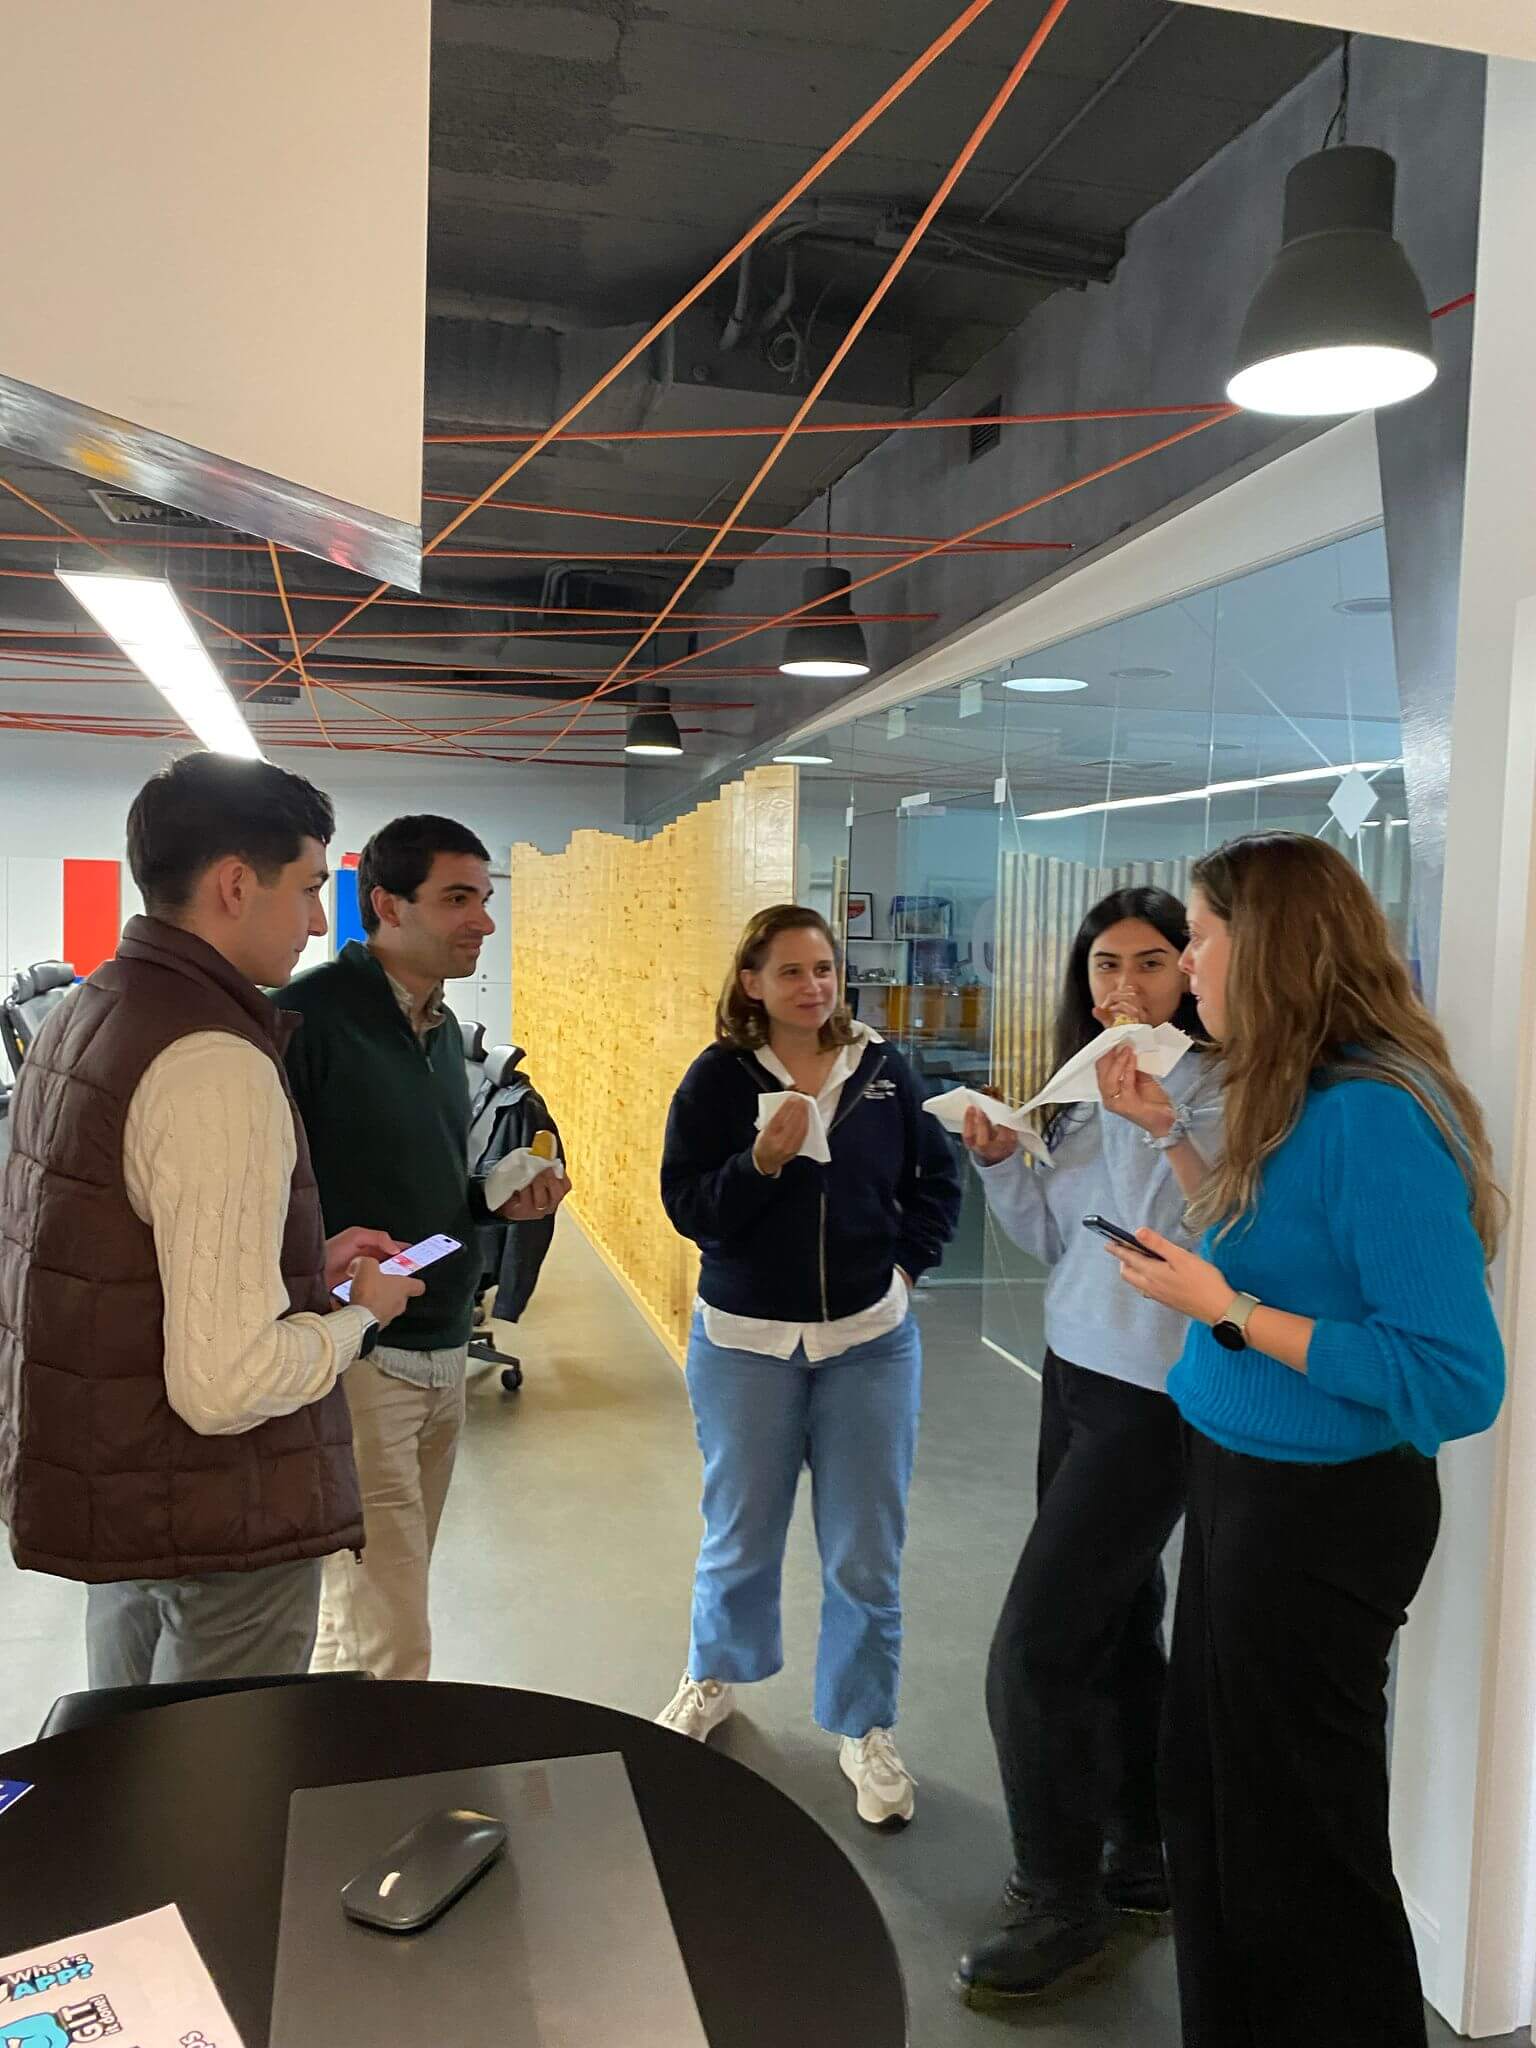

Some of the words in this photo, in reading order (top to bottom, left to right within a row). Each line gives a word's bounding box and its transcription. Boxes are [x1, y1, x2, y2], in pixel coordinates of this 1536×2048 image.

[8, 1955, 87, 1984] What's
[13, 1963, 92, 2000] APP?
[61, 2006, 104, 2042] GIT
